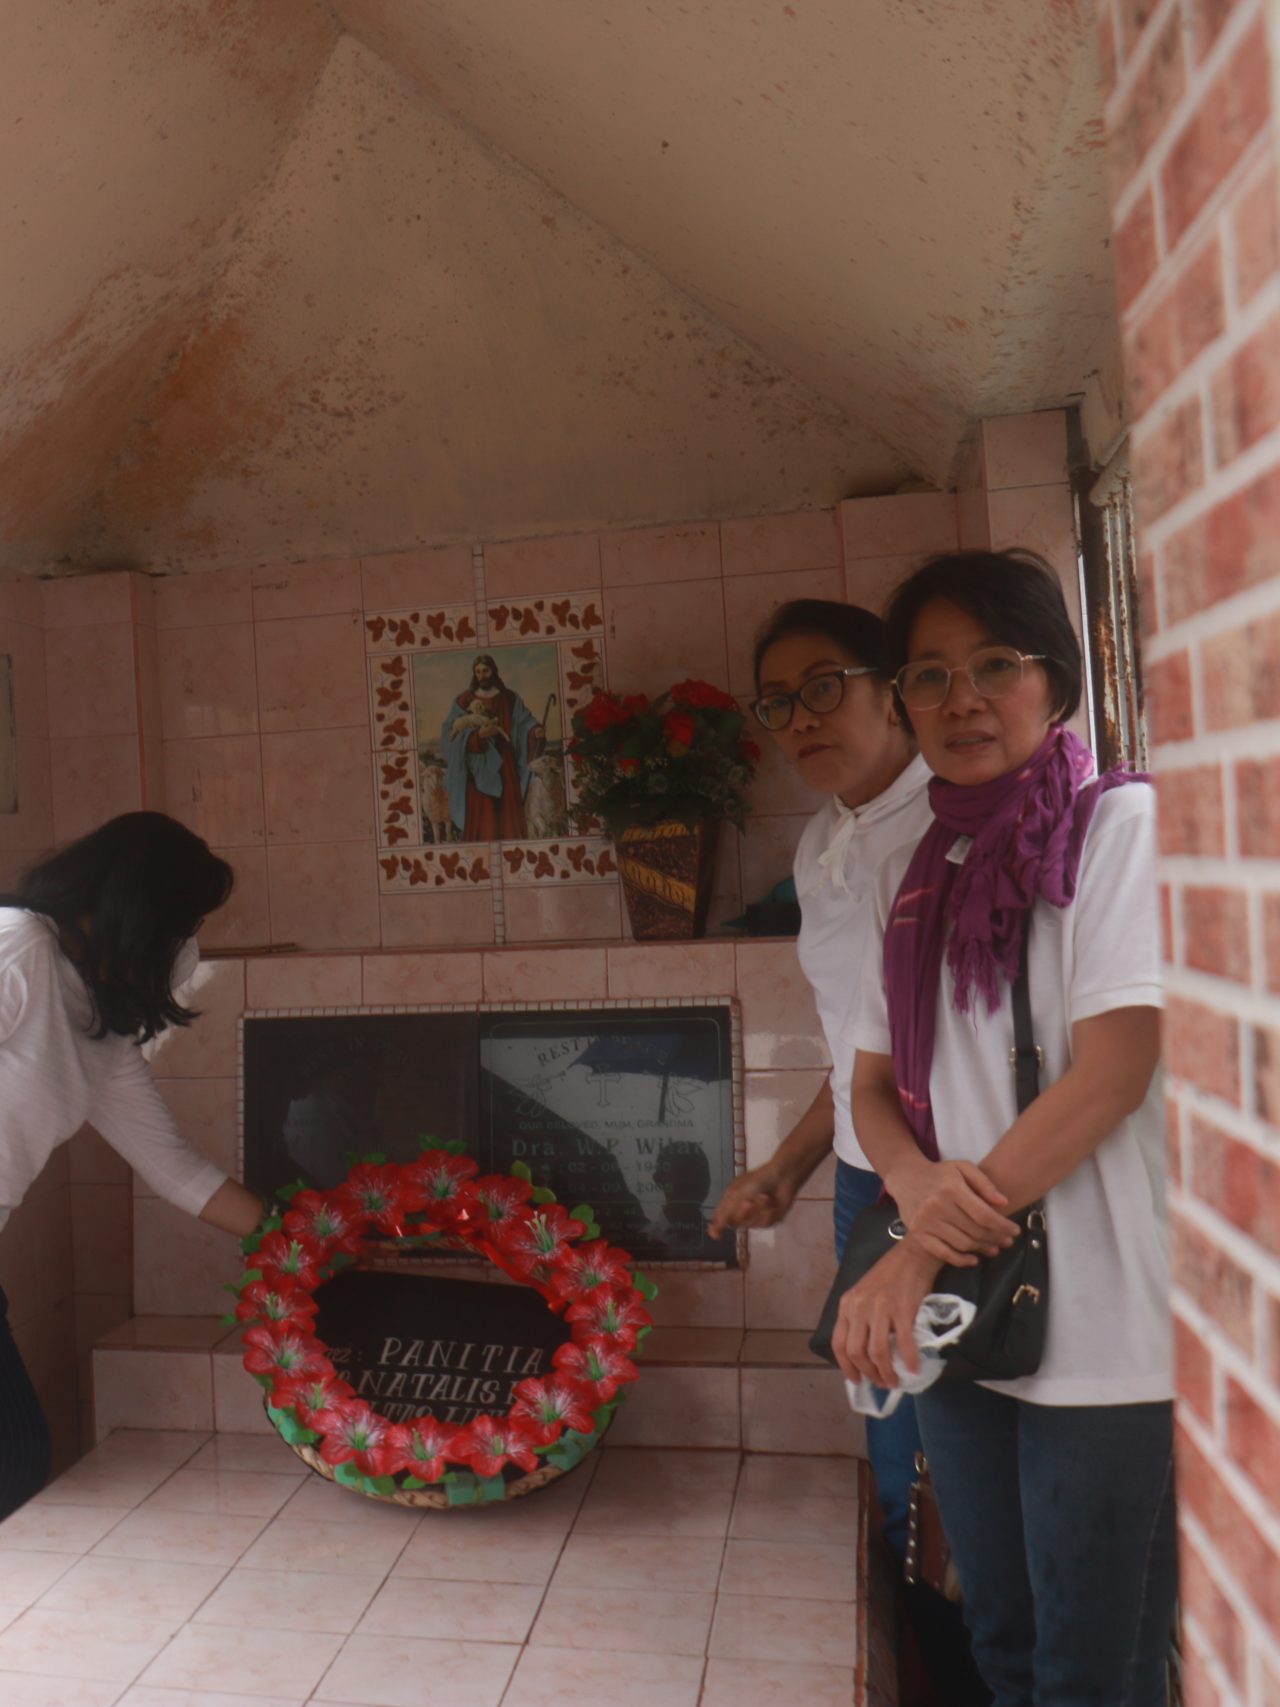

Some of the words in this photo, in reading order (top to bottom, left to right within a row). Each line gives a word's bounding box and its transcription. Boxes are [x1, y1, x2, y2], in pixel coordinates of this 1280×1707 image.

[536, 1038, 581, 1067] REST
[519, 1121, 545, 1131] OUR
[511, 1138, 564, 1157] Dra.
[377, 1336, 546, 1375] PANITIA
[356, 1369, 501, 1406] NATALIS
